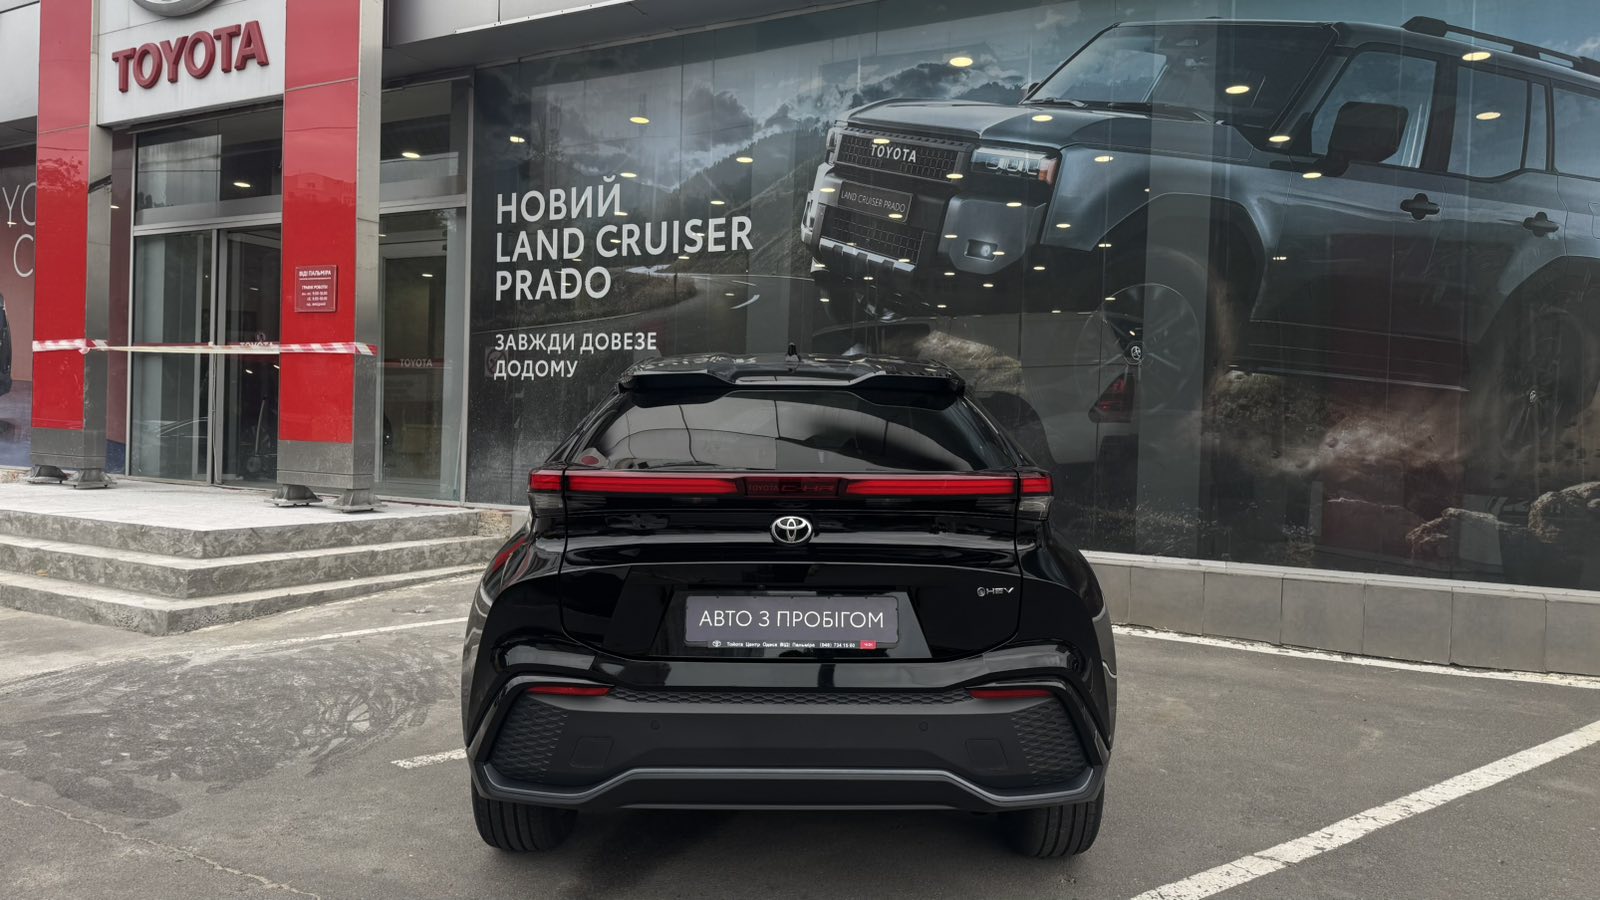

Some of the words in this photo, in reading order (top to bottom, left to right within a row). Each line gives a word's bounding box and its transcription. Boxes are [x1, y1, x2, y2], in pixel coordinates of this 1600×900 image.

[112, 20, 269, 93] TOYOTA
[871, 144, 917, 163] TOYOTA
[496, 175, 621, 224] НОВИЙ
[841, 191, 857, 201] LAND
[858, 194, 883, 207] CRUISER
[883, 201, 906, 213] PRADO
[496, 227, 585, 263] LAND
[596, 215, 753, 258] CRUISER
[495, 265, 612, 301] PRADO
[495, 333, 575, 354] ЗАВЖДИ
[580, 332, 657, 354] ДОВЕЗЕ
[400, 358, 432, 368] TOYOTA
[494, 360, 578, 380] ДОДОМУ
[699, 610, 752, 627] АВТО
[777, 611, 884, 628] ПРОБІГОМ
